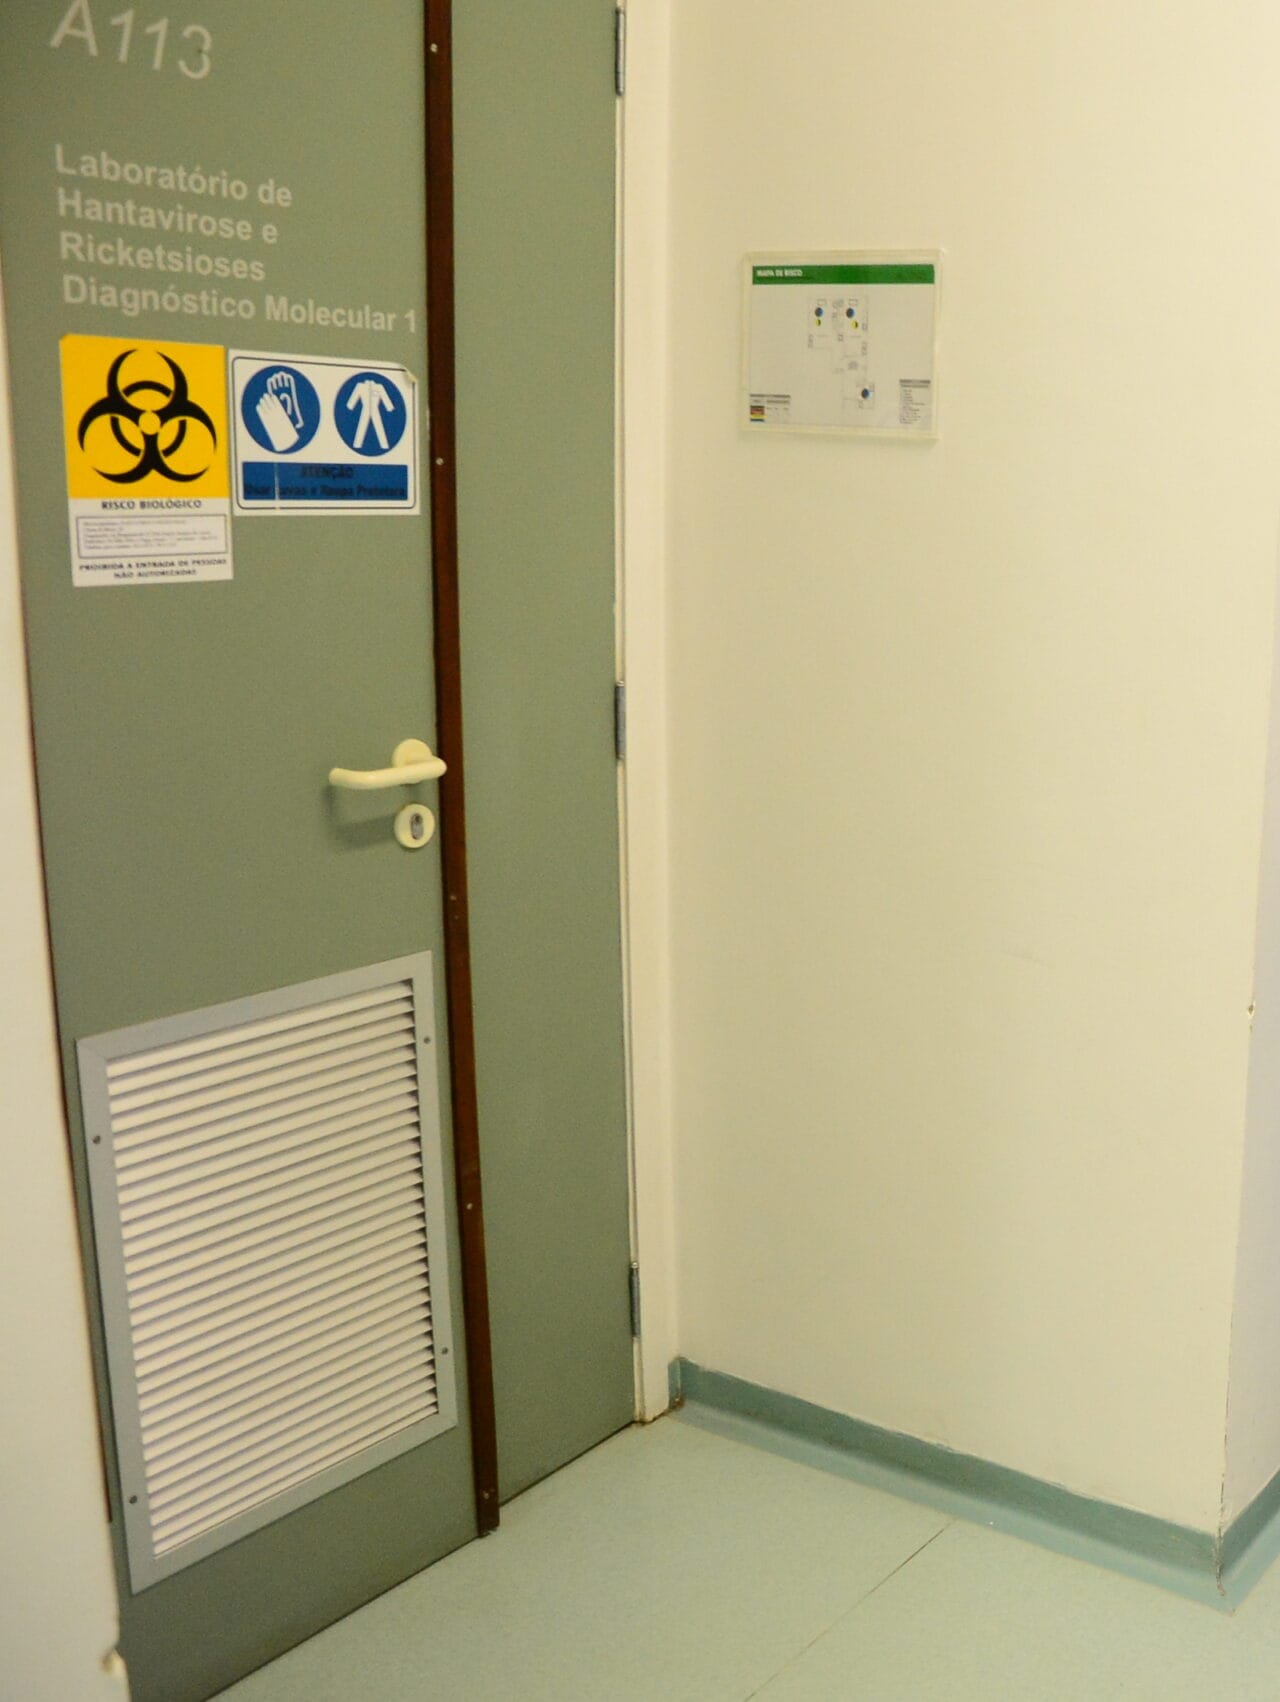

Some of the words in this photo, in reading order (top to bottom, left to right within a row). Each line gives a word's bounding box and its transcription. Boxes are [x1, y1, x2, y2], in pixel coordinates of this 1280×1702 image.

[50, 0, 213, 79] A113
[55, 143, 248, 201] Laboratório
[257, 179, 292, 208] de
[57, 187, 252, 242] Hantavirose
[262, 224, 278, 245] e
[59, 231, 266, 282] Ricketsioses
[62, 274, 256, 320] Diagnóstico
[265, 295, 397, 332] Molecular
[403, 310, 417, 334] 1
[101, 500, 135, 510] RISCO
[140, 499, 202, 510] BIOLÓGICO
